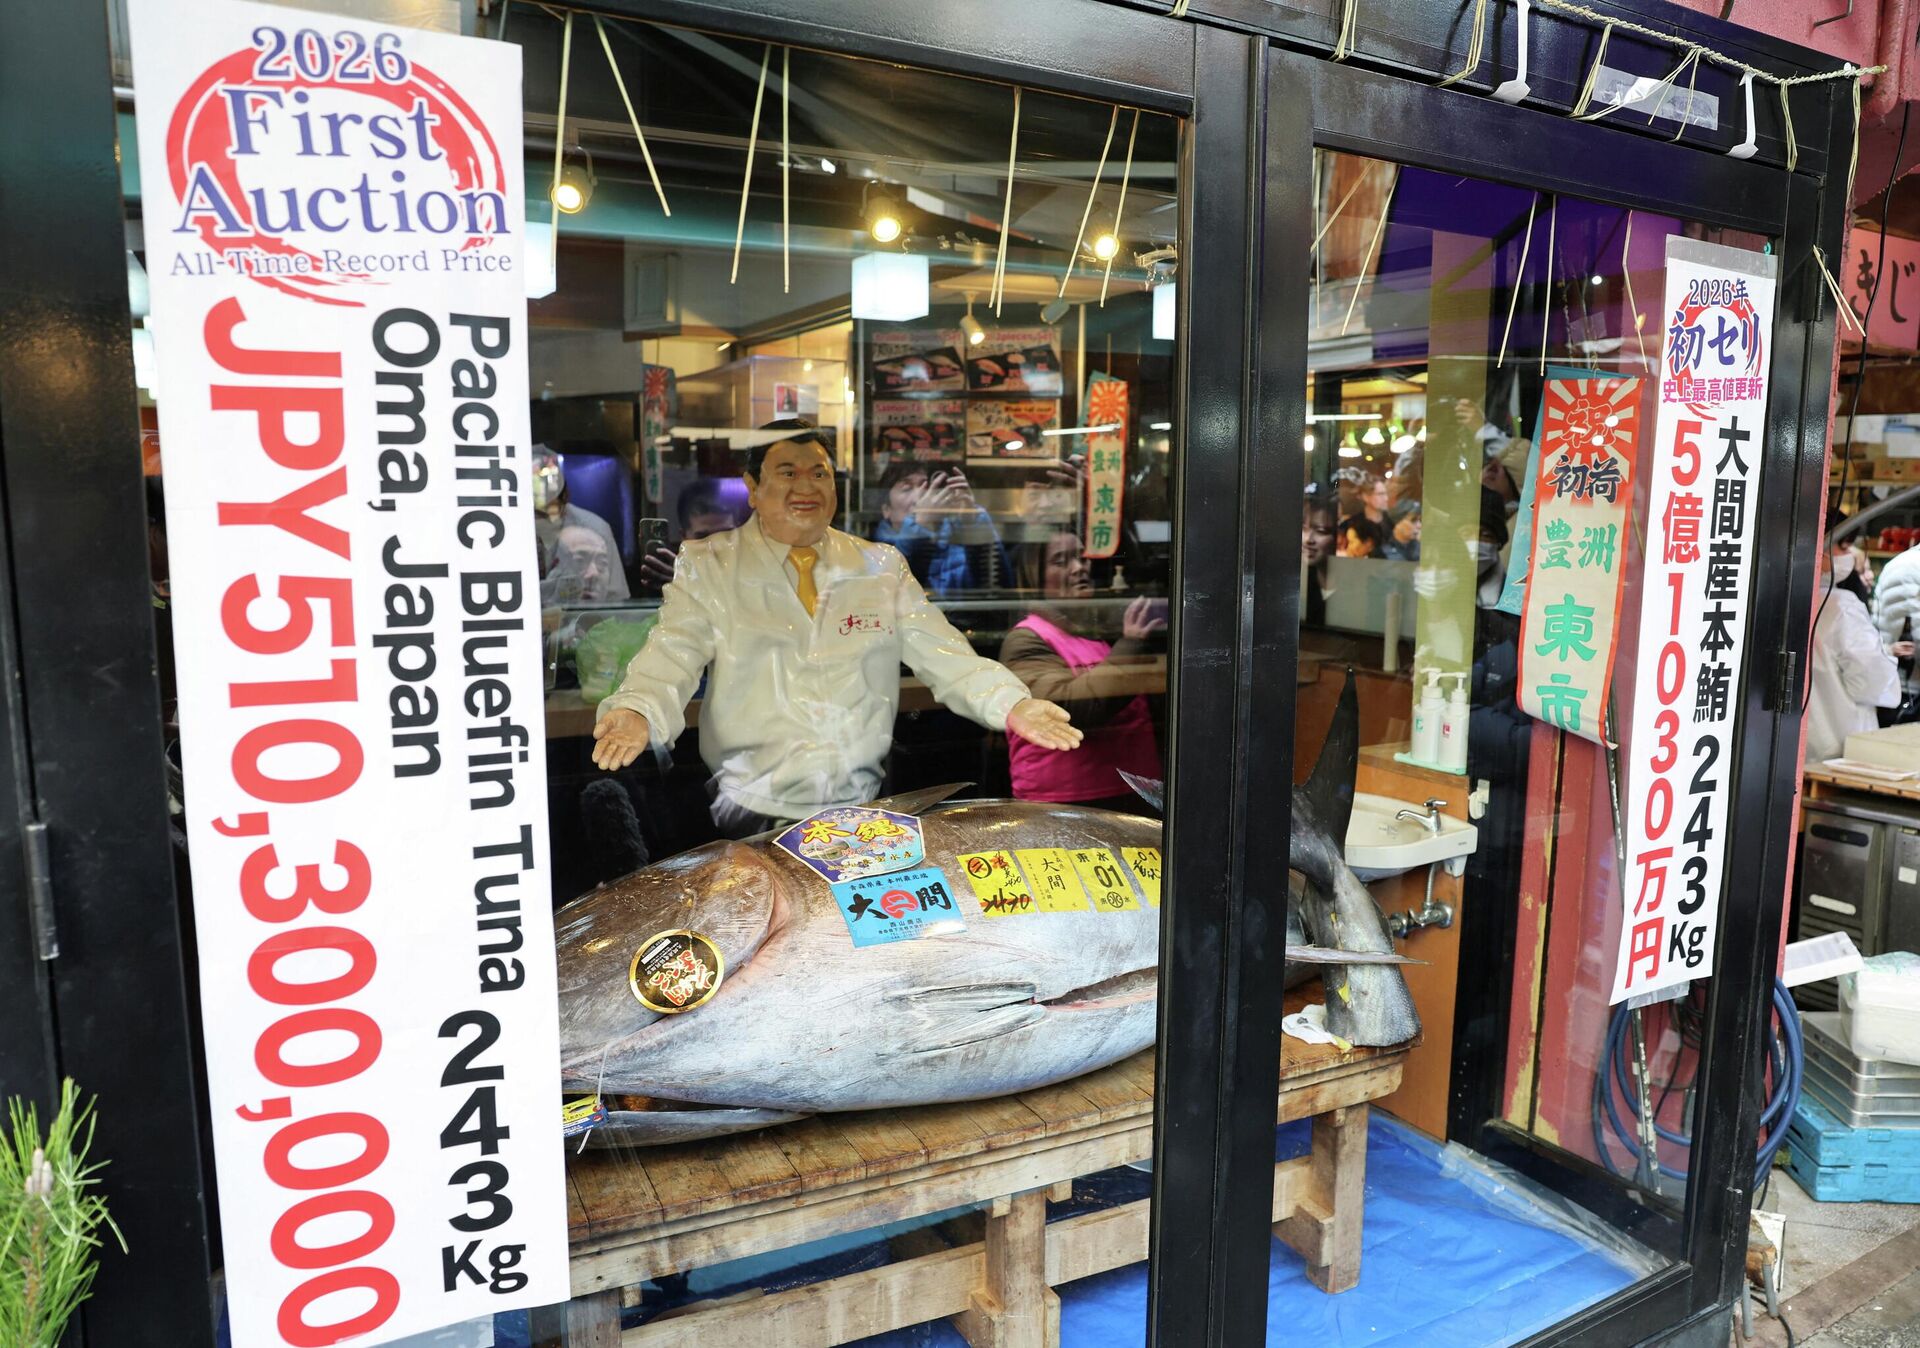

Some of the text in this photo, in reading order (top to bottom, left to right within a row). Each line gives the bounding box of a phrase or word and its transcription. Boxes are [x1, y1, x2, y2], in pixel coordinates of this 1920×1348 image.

[251, 26, 410, 81] 2026
[223, 87, 443, 161] First
[171, 166, 511, 235] Auction
[170, 249, 512, 276] All-Time Record Price
[1689, 278, 1749, 307] 2026年
[1667, 311, 1760, 374] 初セリ
[1662, 376, 1764, 404] 史上最高値更新
[450, 312, 519, 549] Pacific
[1546, 455, 1621, 503] 初荷
[367, 307, 449, 779] Oma, Japan
[1540, 517, 1618, 574] 豊洲
[460, 571, 530, 810] Bluefin
[1535, 593, 1598, 731] 東市
[1625, 420, 1704, 990] 5億1030万円
[1041, 857, 1066, 891] 大間
[1094, 865, 1124, 888] 01
[472, 824, 535, 993] Tuna
